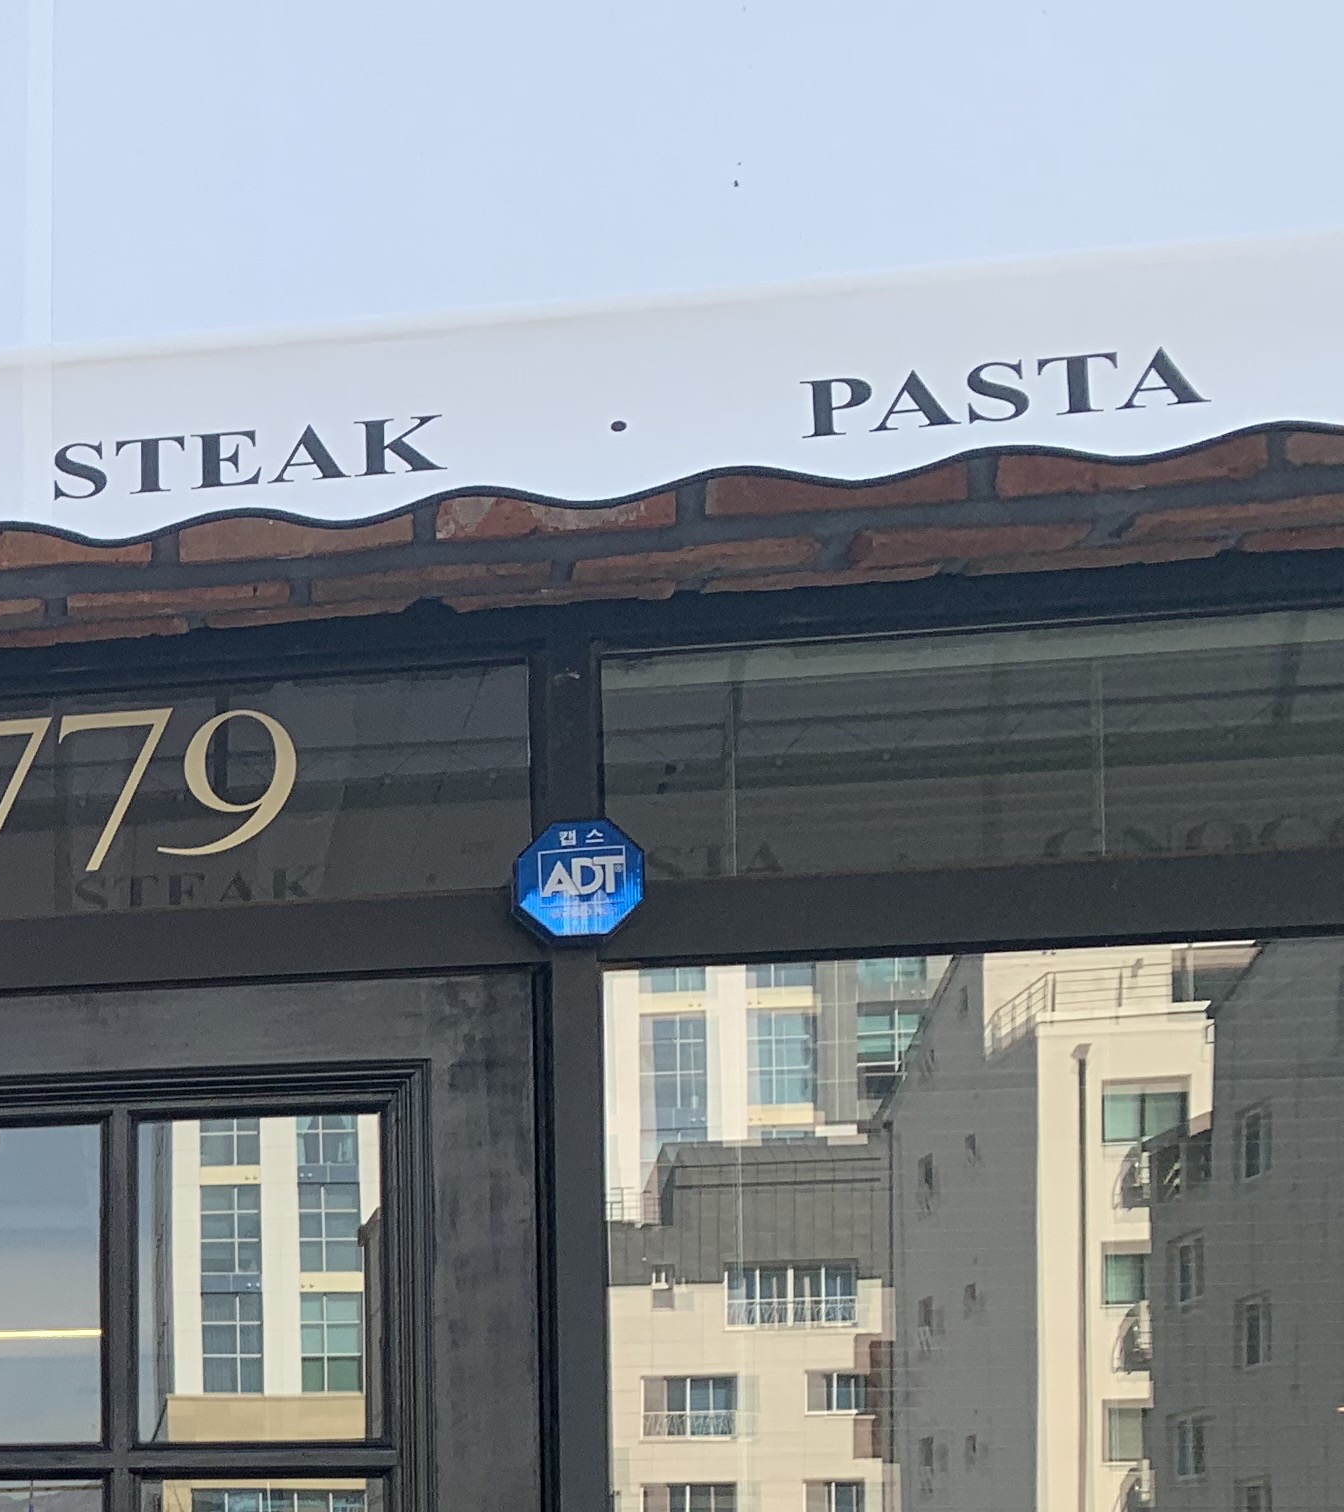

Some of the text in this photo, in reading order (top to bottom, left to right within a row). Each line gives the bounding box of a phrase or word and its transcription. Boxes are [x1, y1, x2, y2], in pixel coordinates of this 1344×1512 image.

[52, 345, 1211, 500] STEAK PASTA
[558, 828, 605, 846] 캡스
[541, 855, 624, 897] ADT
